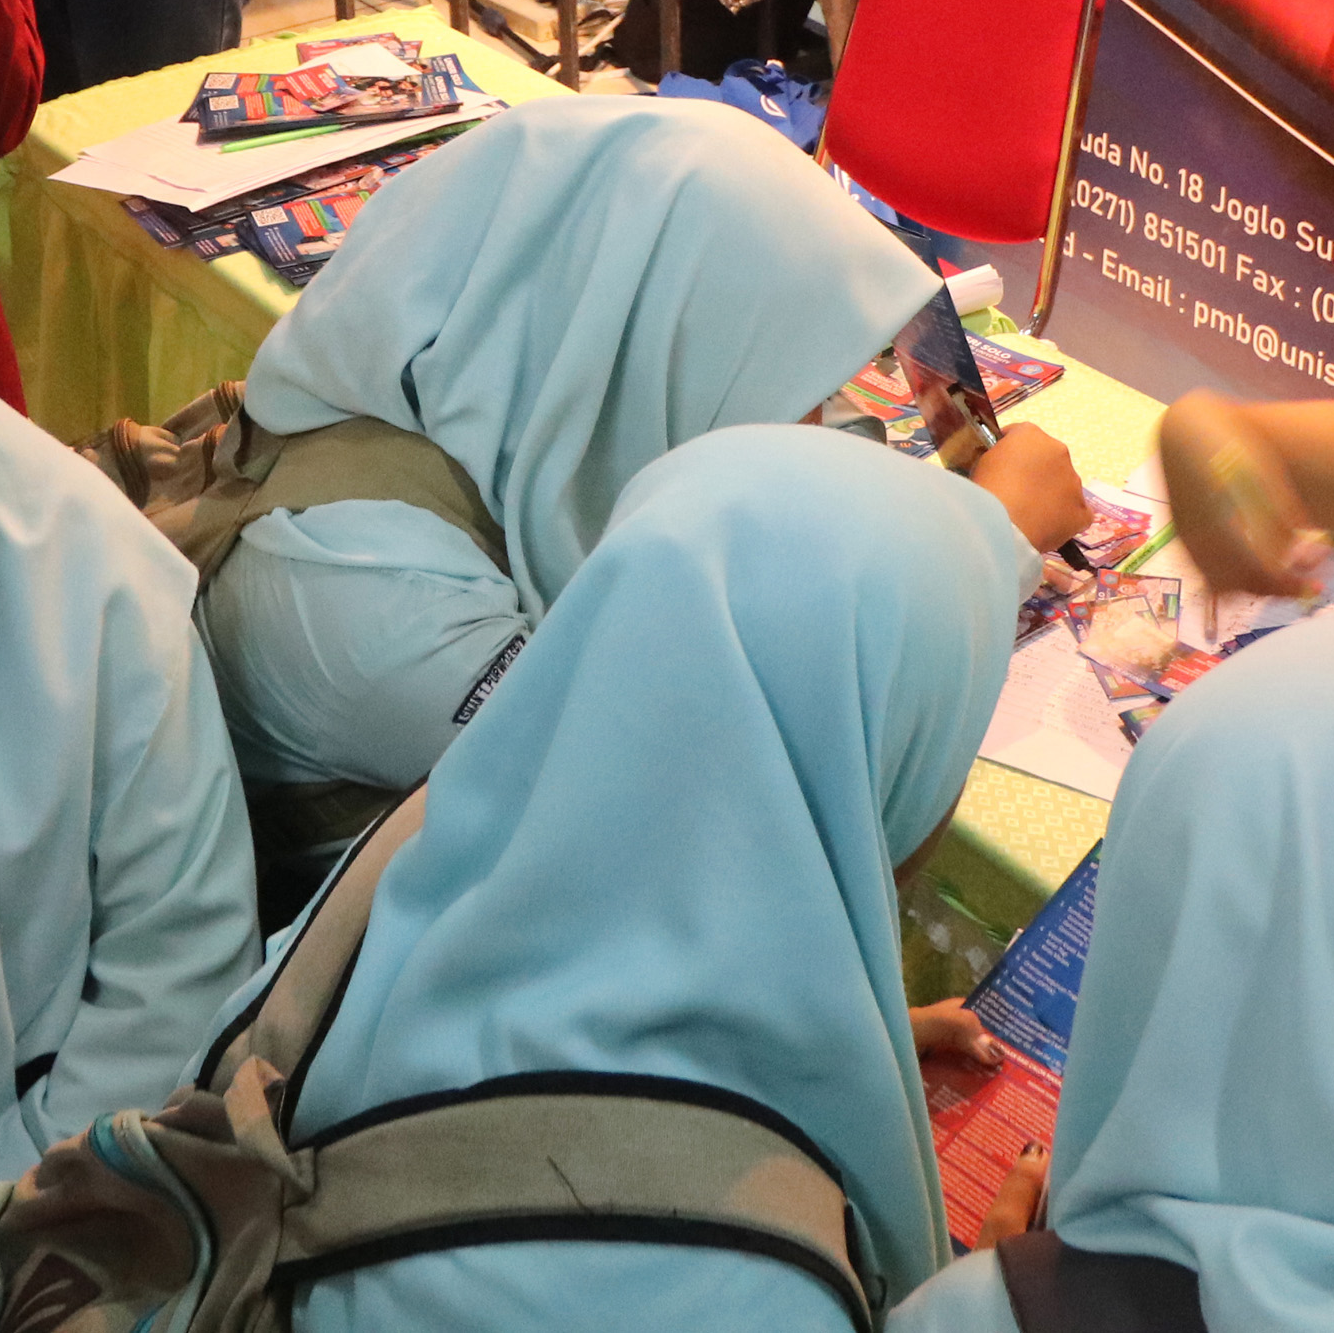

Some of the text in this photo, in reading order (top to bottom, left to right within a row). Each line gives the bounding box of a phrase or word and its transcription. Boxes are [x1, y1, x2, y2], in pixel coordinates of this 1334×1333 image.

[1129, 145, 1169, 189] No.
[1178, 168, 1204, 204] 18
[1211, 186, 1286, 240] Joglo
[1102, 248, 1172, 307] Email
[1144, 211, 1228, 275] 851501
[1236, 253, 1286, 301] Fax
